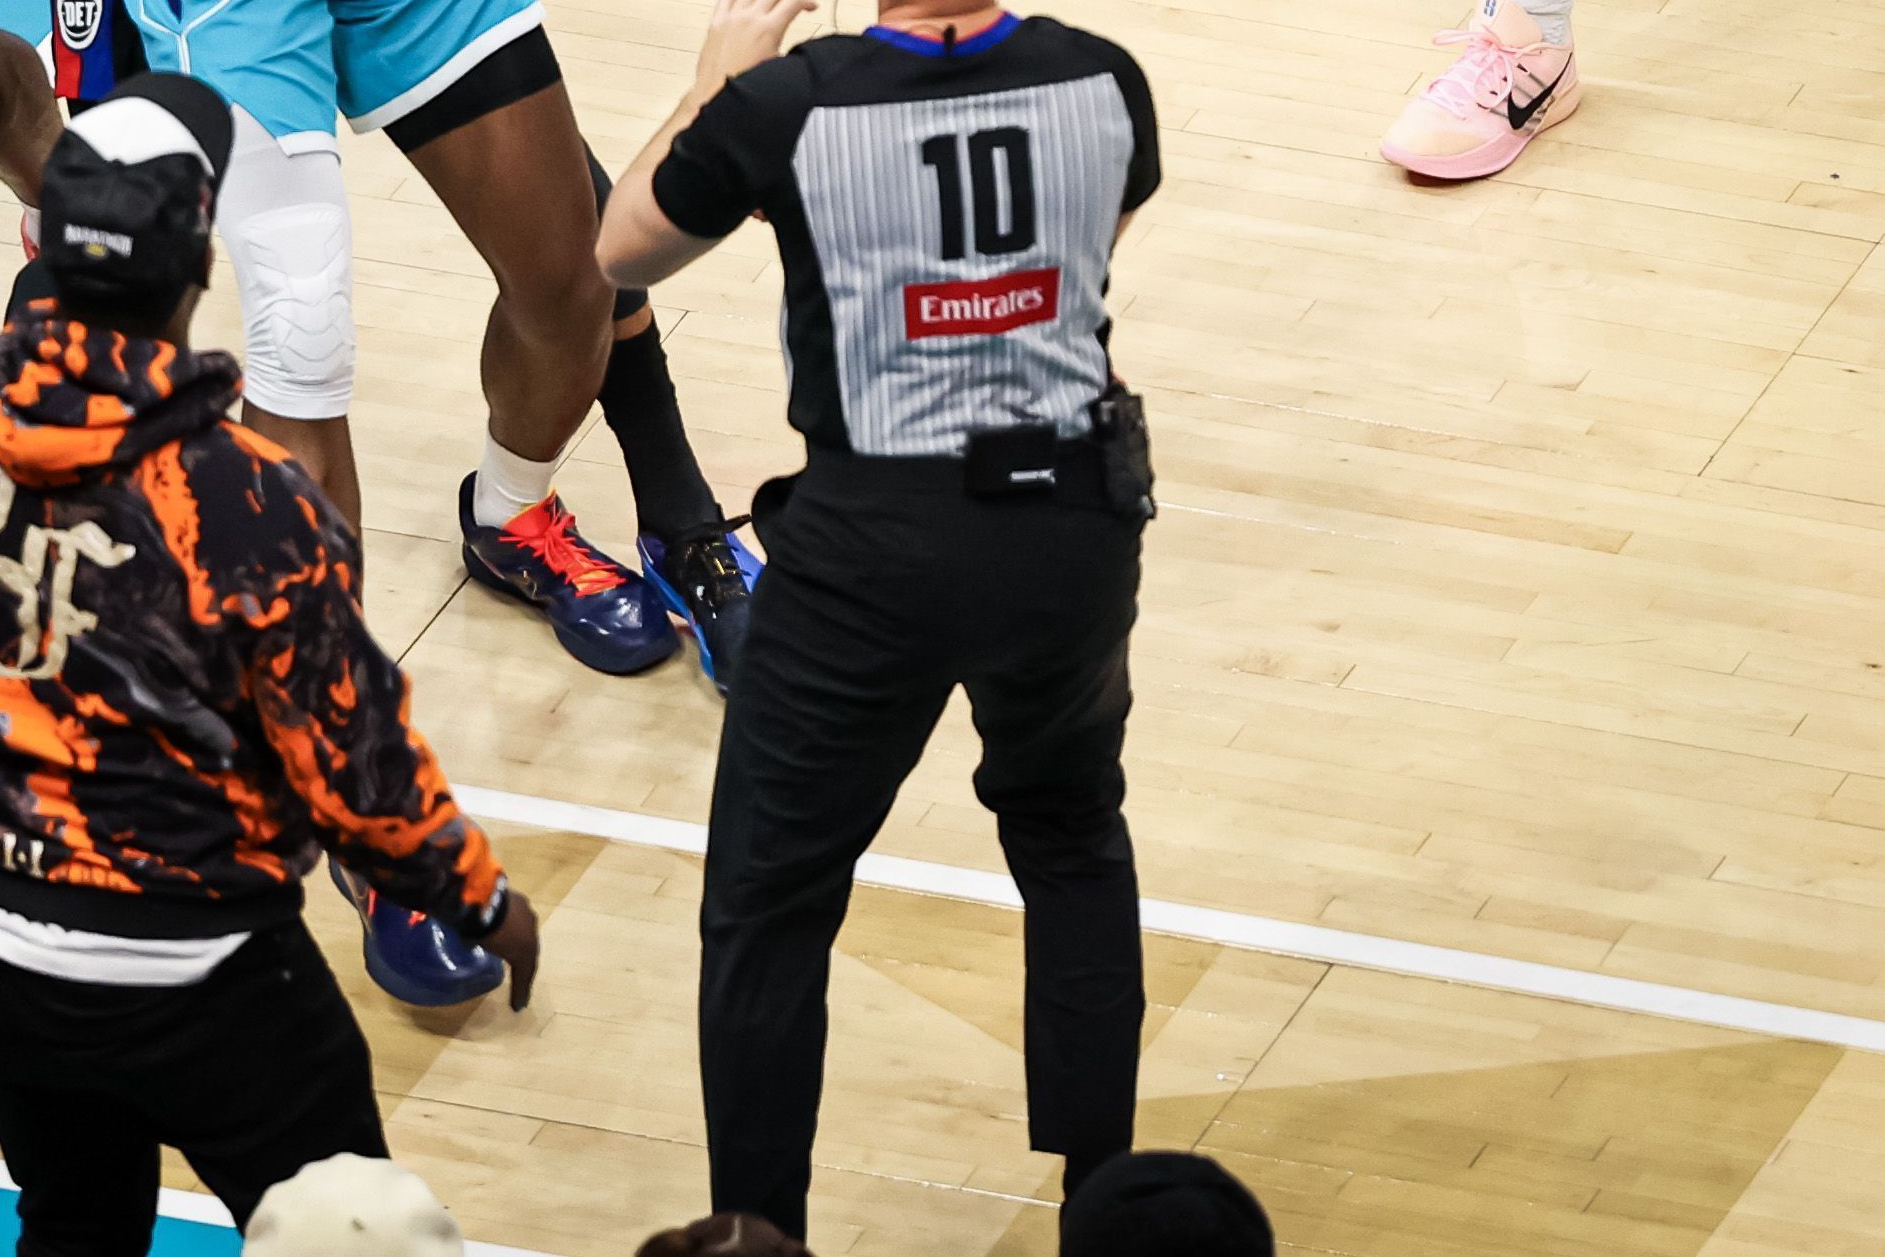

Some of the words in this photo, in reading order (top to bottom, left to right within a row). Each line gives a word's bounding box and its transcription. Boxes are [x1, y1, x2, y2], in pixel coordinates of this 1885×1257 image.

[64, 1, 96, 27] DET
[920, 125, 1038, 261] 10
[920, 286, 1044, 323] Emirates
